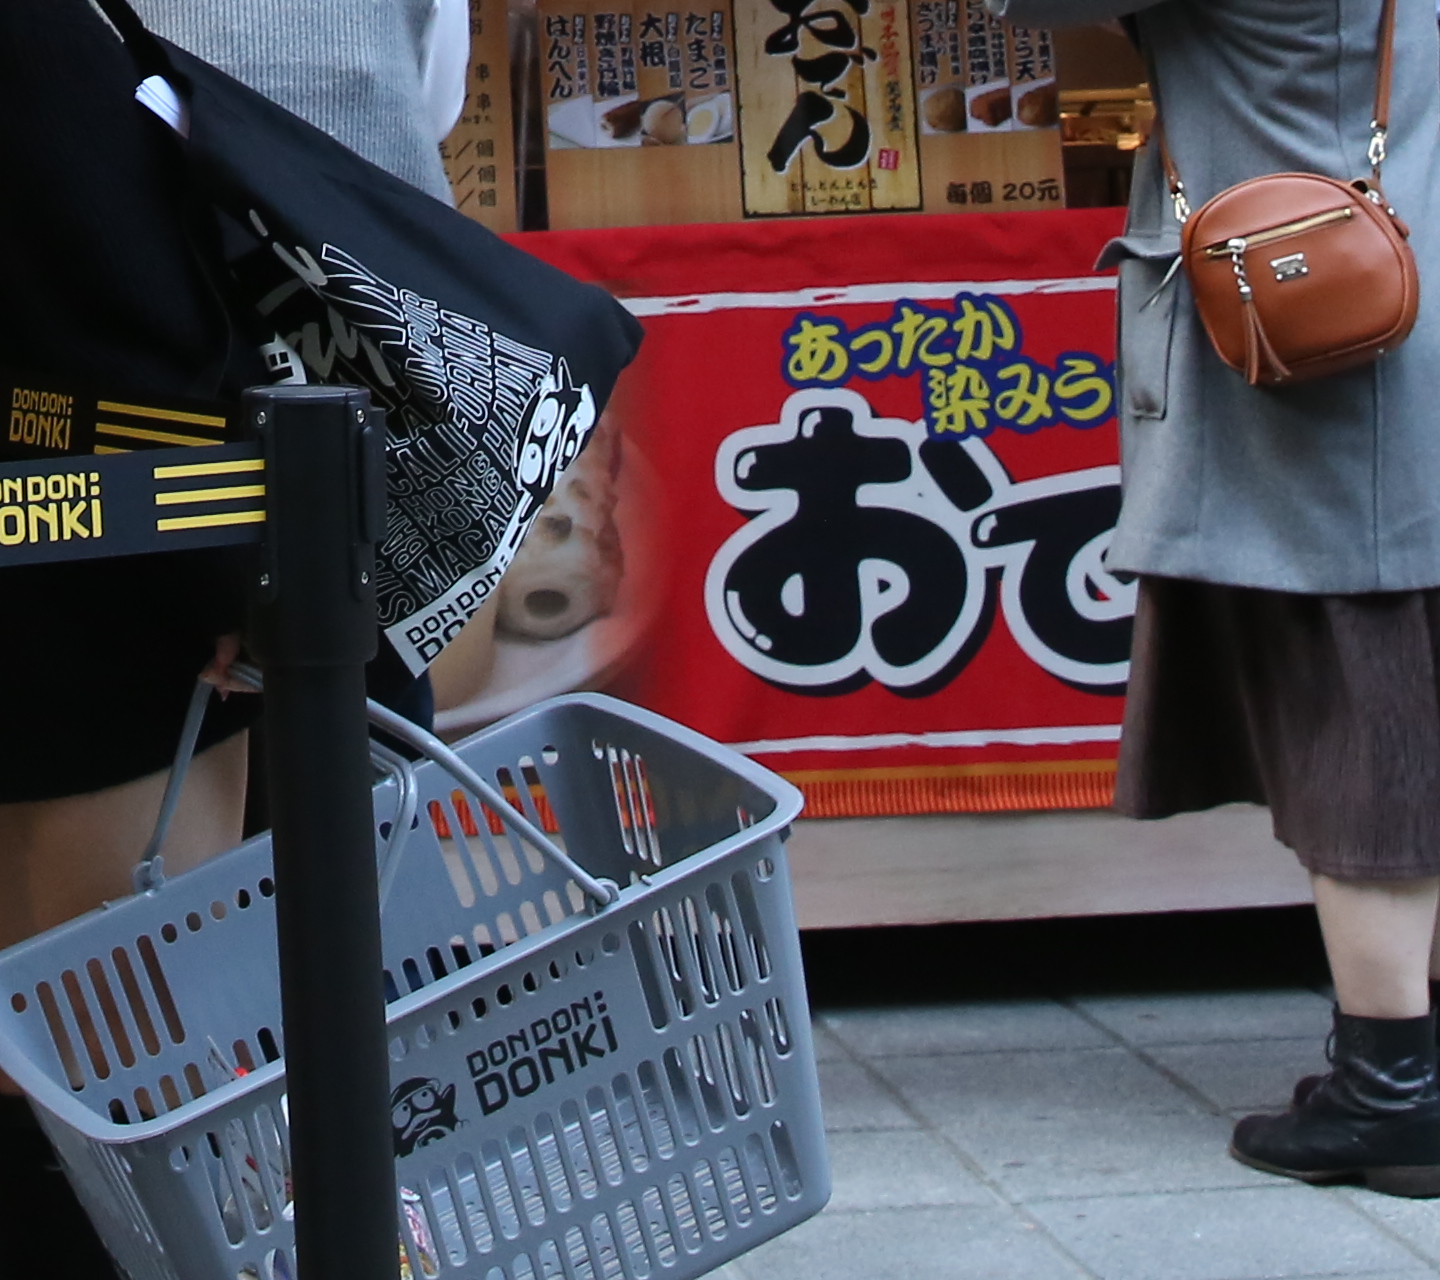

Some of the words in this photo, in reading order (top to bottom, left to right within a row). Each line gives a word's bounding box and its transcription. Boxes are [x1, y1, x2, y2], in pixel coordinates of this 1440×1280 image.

[639, 12, 666, 67] 大根
[684, 11, 710, 89] たまご
[400, 289, 448, 406] UMPUR
[789, 295, 1014, 383] あったか
[10, 410, 70, 450] DONKI
[12, 388, 39, 410] DON
[929, 359, 1112, 436] 染みう
[400, 450, 490, 521] HONG
[420, 466, 502, 542] KONG
[402, 480, 518, 604] MACAU
[712, 393, 1139, 681] おで
[405, 603, 459, 646] DON
[466, 1028, 531, 1079] DON
[473, 1014, 618, 1117] DONKI
